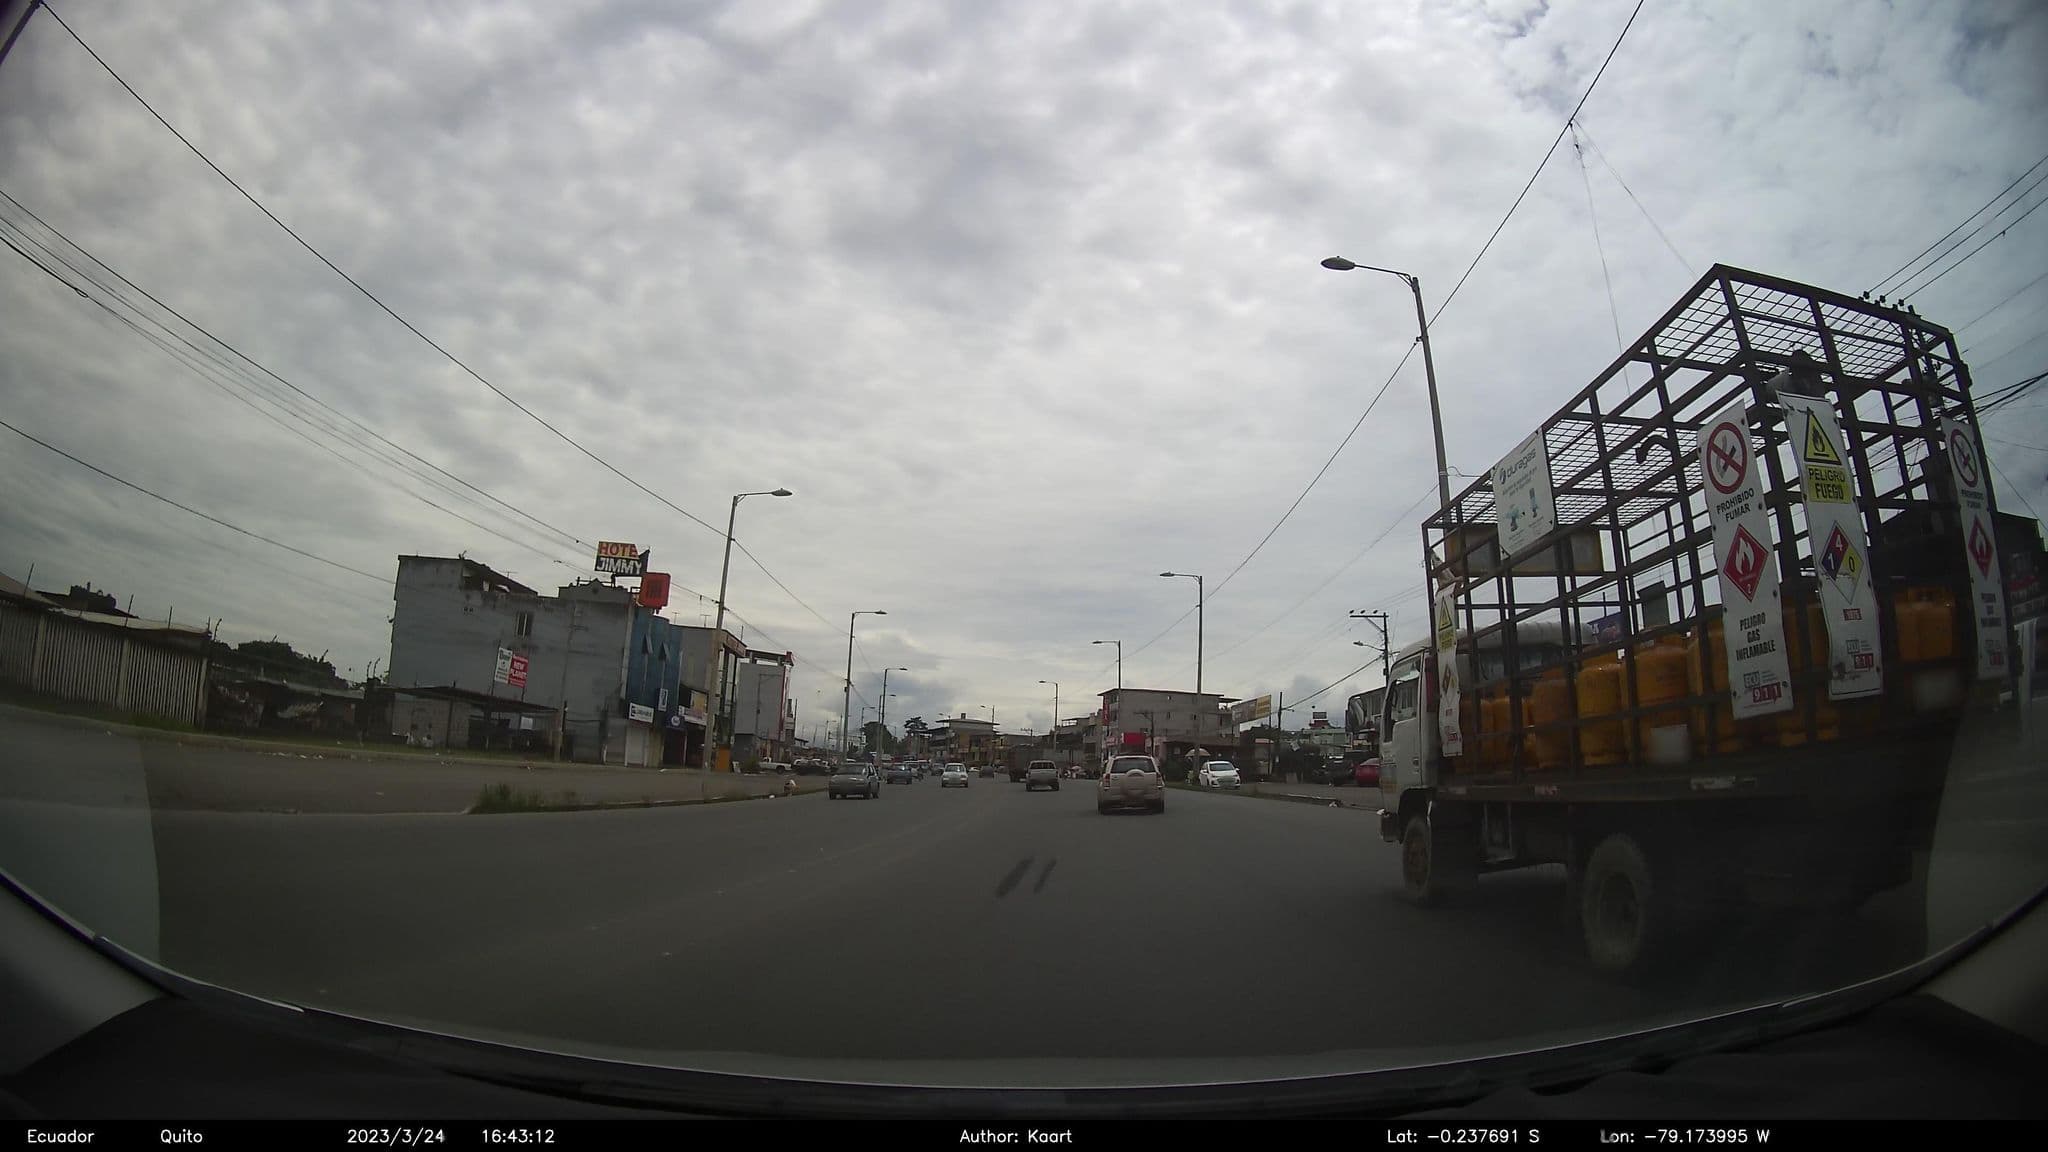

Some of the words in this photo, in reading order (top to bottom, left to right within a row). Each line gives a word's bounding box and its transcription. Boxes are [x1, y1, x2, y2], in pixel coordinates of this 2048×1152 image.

[1808, 468, 1845, 482] PELIGRO
[1814, 483, 1844, 500] FUEGO
[1717, 488, 1754, 514] PROHIBIDO
[1725, 504, 1751, 523] FUMAR
[1835, 535, 1843, 551] 4
[597, 557, 642, 574] JIMMY
[1828, 553, 1835, 570] 1
[1848, 556, 1856, 573] 0
[1740, 612, 1766, 631] PELIGRO
[1747, 629, 1761, 643] GAS
[1736, 640, 1776, 661] INFLAMABLE
[1754, 684, 1778, 700] 911
